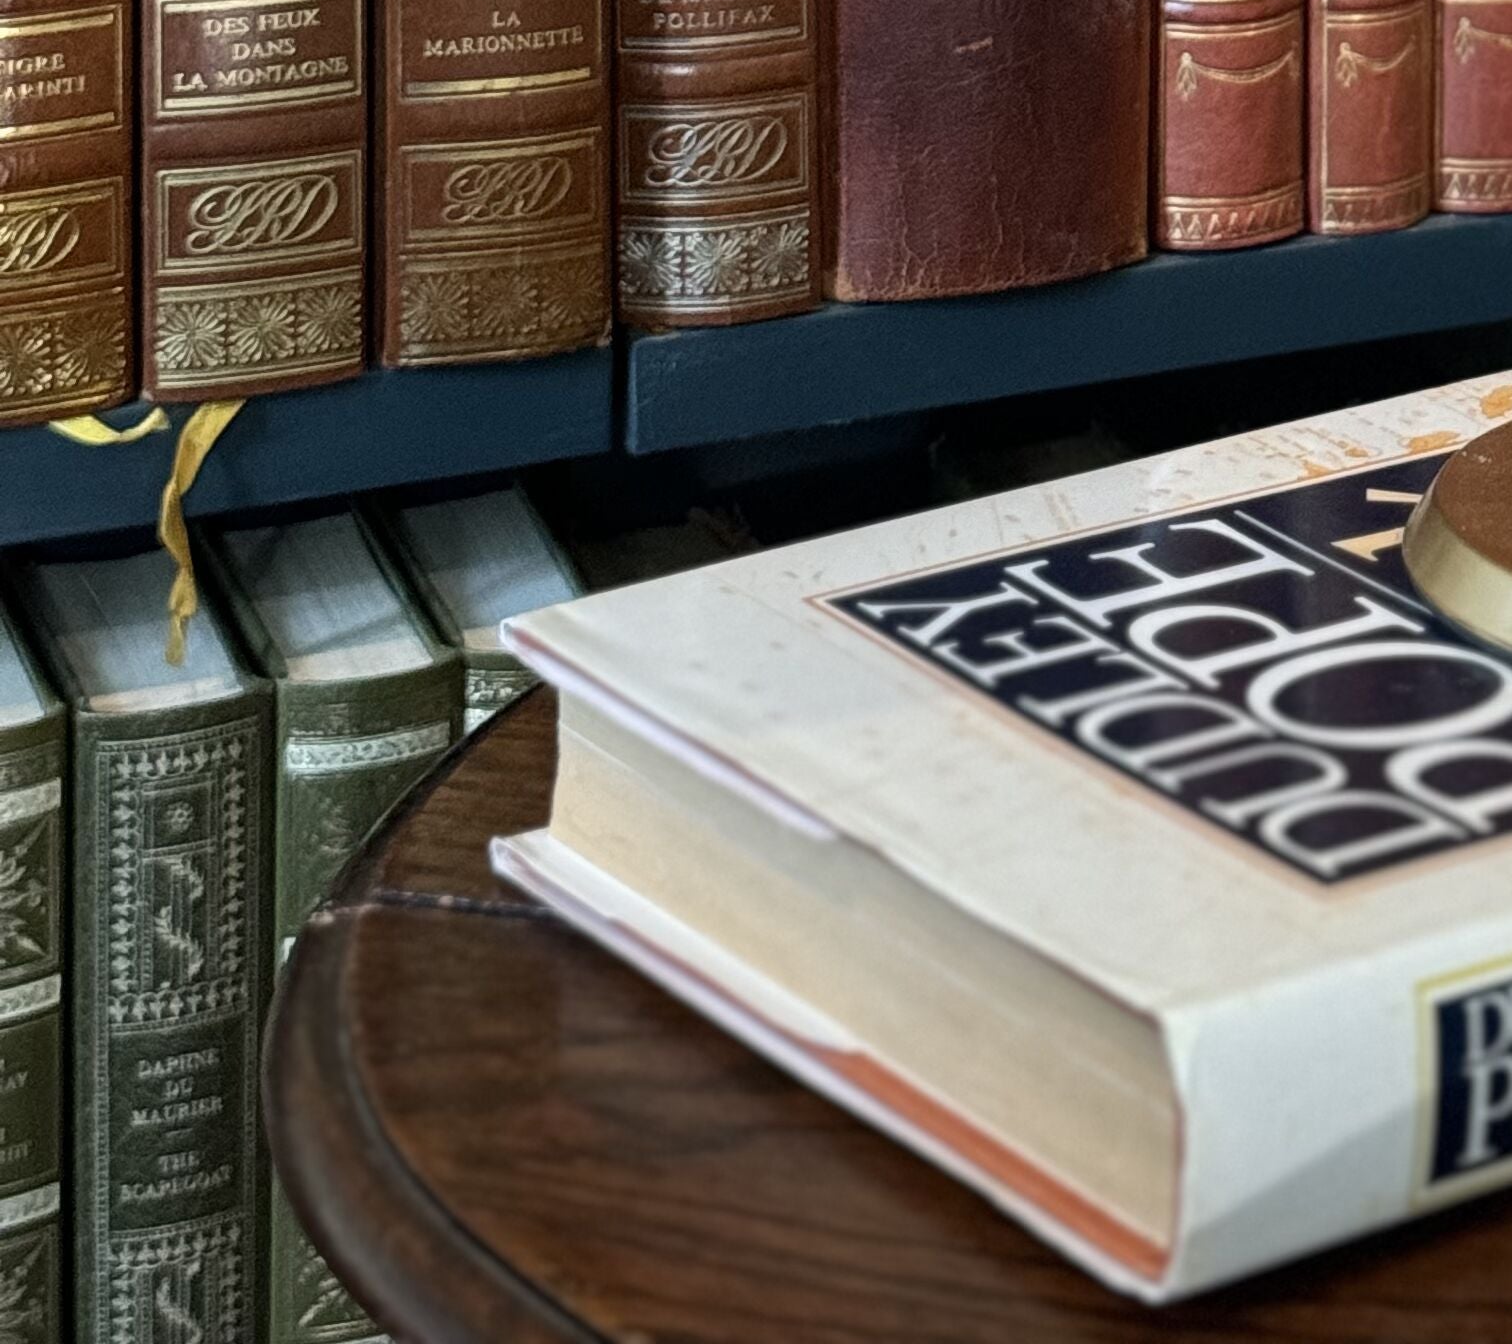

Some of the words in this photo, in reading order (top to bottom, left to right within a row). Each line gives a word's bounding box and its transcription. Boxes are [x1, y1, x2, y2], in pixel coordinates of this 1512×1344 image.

[201, 16, 250, 38] DES
[258, 7, 321, 32] FEUX
[491, 10, 522, 28] LA
[652, 4, 776, 30] POLLIFAX
[231, 37, 298, 62] DANS
[421, 24, 585, 58] MARIONNETTE
[173, 72, 209, 93] LA
[217, 56, 350, 89] MONTAGNE
[856, 580, 1474, 878] DUDLEY
[164, 1076, 194, 1101] DU
[157, 1150, 201, 1173] THE
